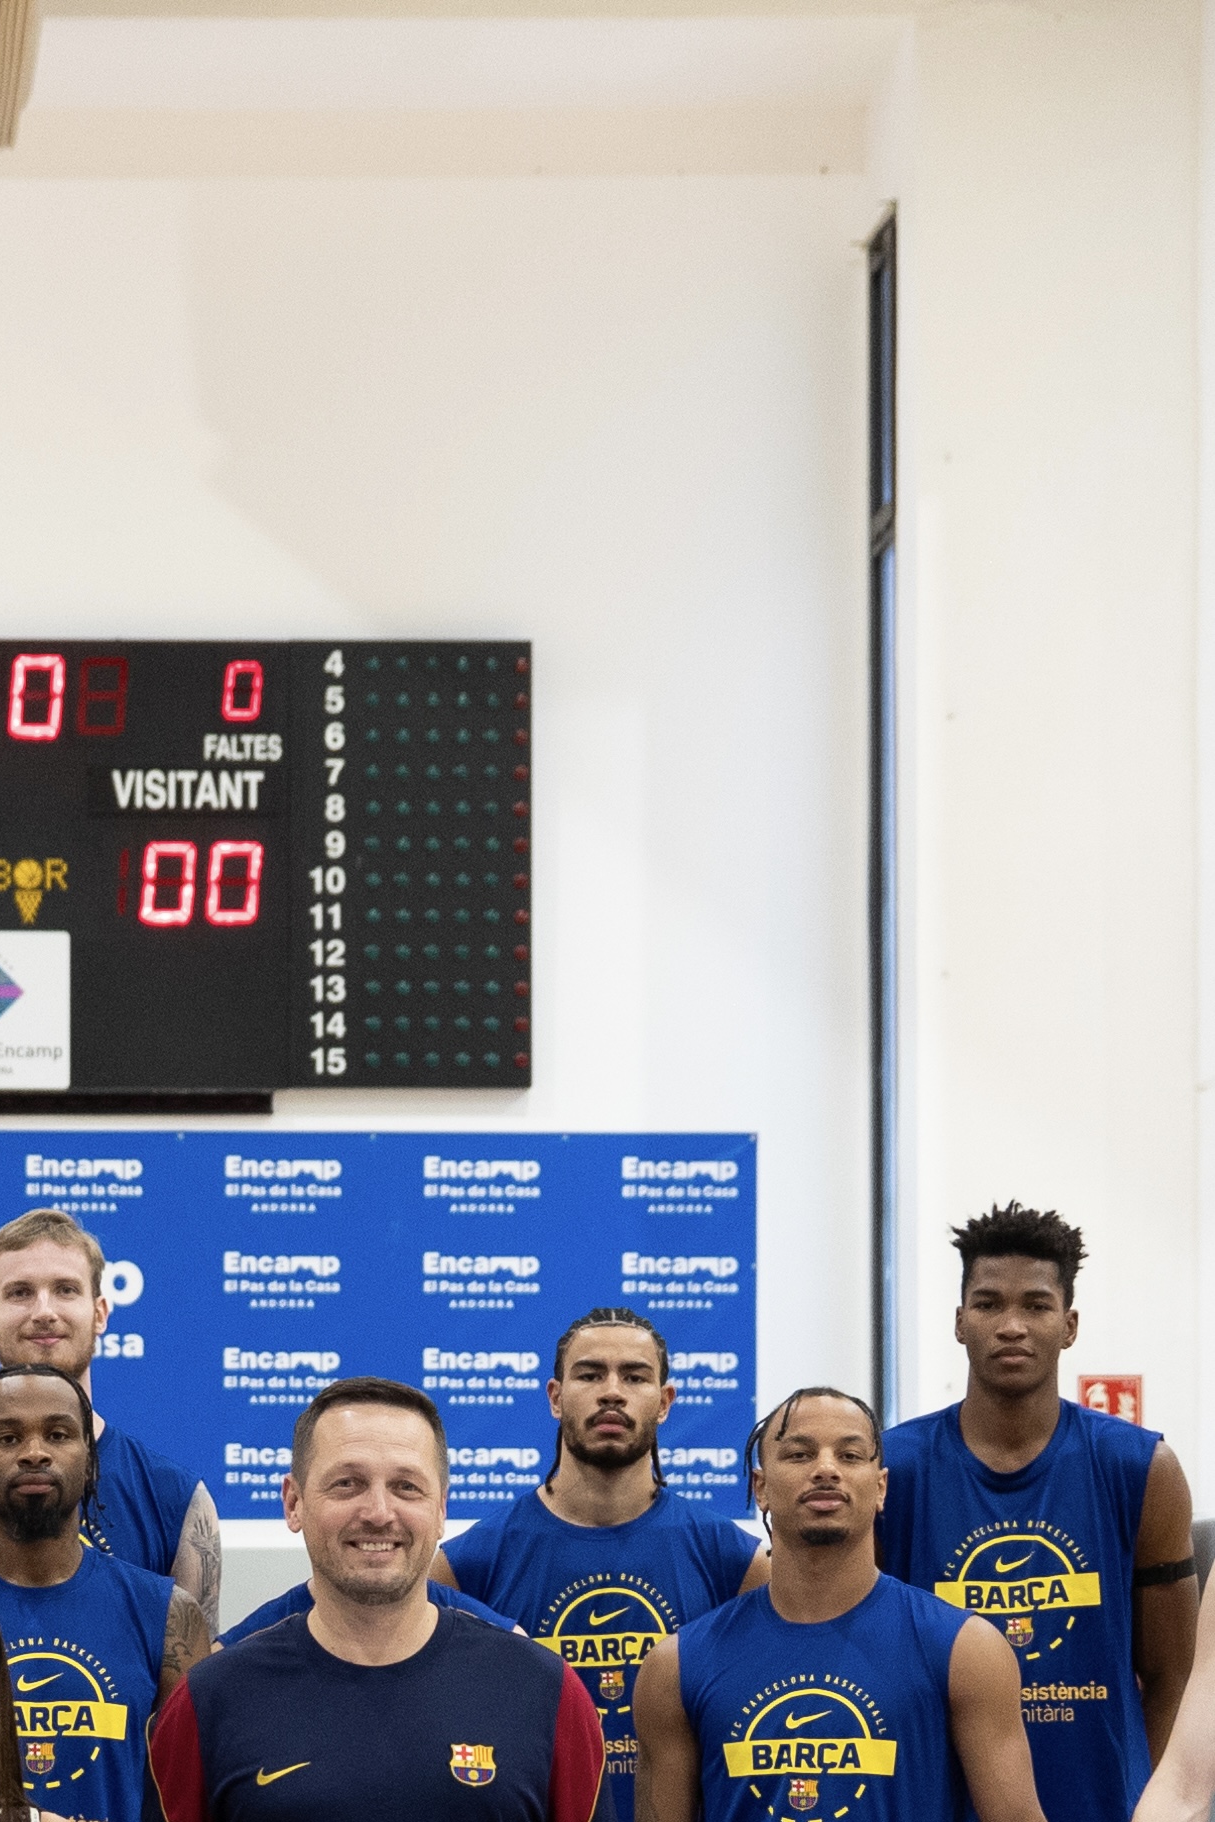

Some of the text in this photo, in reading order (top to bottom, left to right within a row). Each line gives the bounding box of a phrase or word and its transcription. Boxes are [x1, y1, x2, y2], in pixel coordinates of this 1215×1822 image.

[324, 650, 344, 677] 4
[221, 660, 263, 722] 0
[325, 686, 345, 714] 5
[204, 734, 282, 761] FALTES
[324, 722, 345, 750] 6
[325, 758, 344, 786] 7
[112, 770, 264, 810] VISITANT
[325, 794, 345, 822] 8
[325, 830, 345, 858] 9
[138, 840, 264, 928] 00
[310, 866, 345, 894] 10
[310, 903, 342, 930] 11
[310, 939, 345, 967] 12
[310, 975, 346, 1003] 13
[310, 1012, 346, 1038] 14
[311, 1048, 346, 1075] 15
[26, 1155, 142, 1180] Encamp
[225, 1155, 342, 1181] Encamp
[424, 1156, 540, 1182] Encamp
[622, 1156, 738, 1182] Encamp
[224, 1251, 340, 1277] Encamp
[423, 1252, 540, 1277] Encamp
[622, 1252, 738, 1277] Encamp
[224, 1280, 340, 1293] El Pas de la Casa
[250, 1299, 314, 1308] ANDORRA
[223, 1347, 340, 1373] Encamp
[423, 1348, 539, 1373] Encamp
[226, 1443, 292, 1465] Enca
[447, 1448, 540, 1468] ncamp
[659, 1448, 737, 1468] camp
[965, 1579, 1070, 1611] BARÇA
[560, 1636, 656, 1664] BARÇA
[1021, 1681, 1108, 1701] sistència
[14, 1705, 95, 1738] ARÇA
[1022, 1702, 1075, 1723] nitària
[752, 1743, 861, 1773] BARÇA
